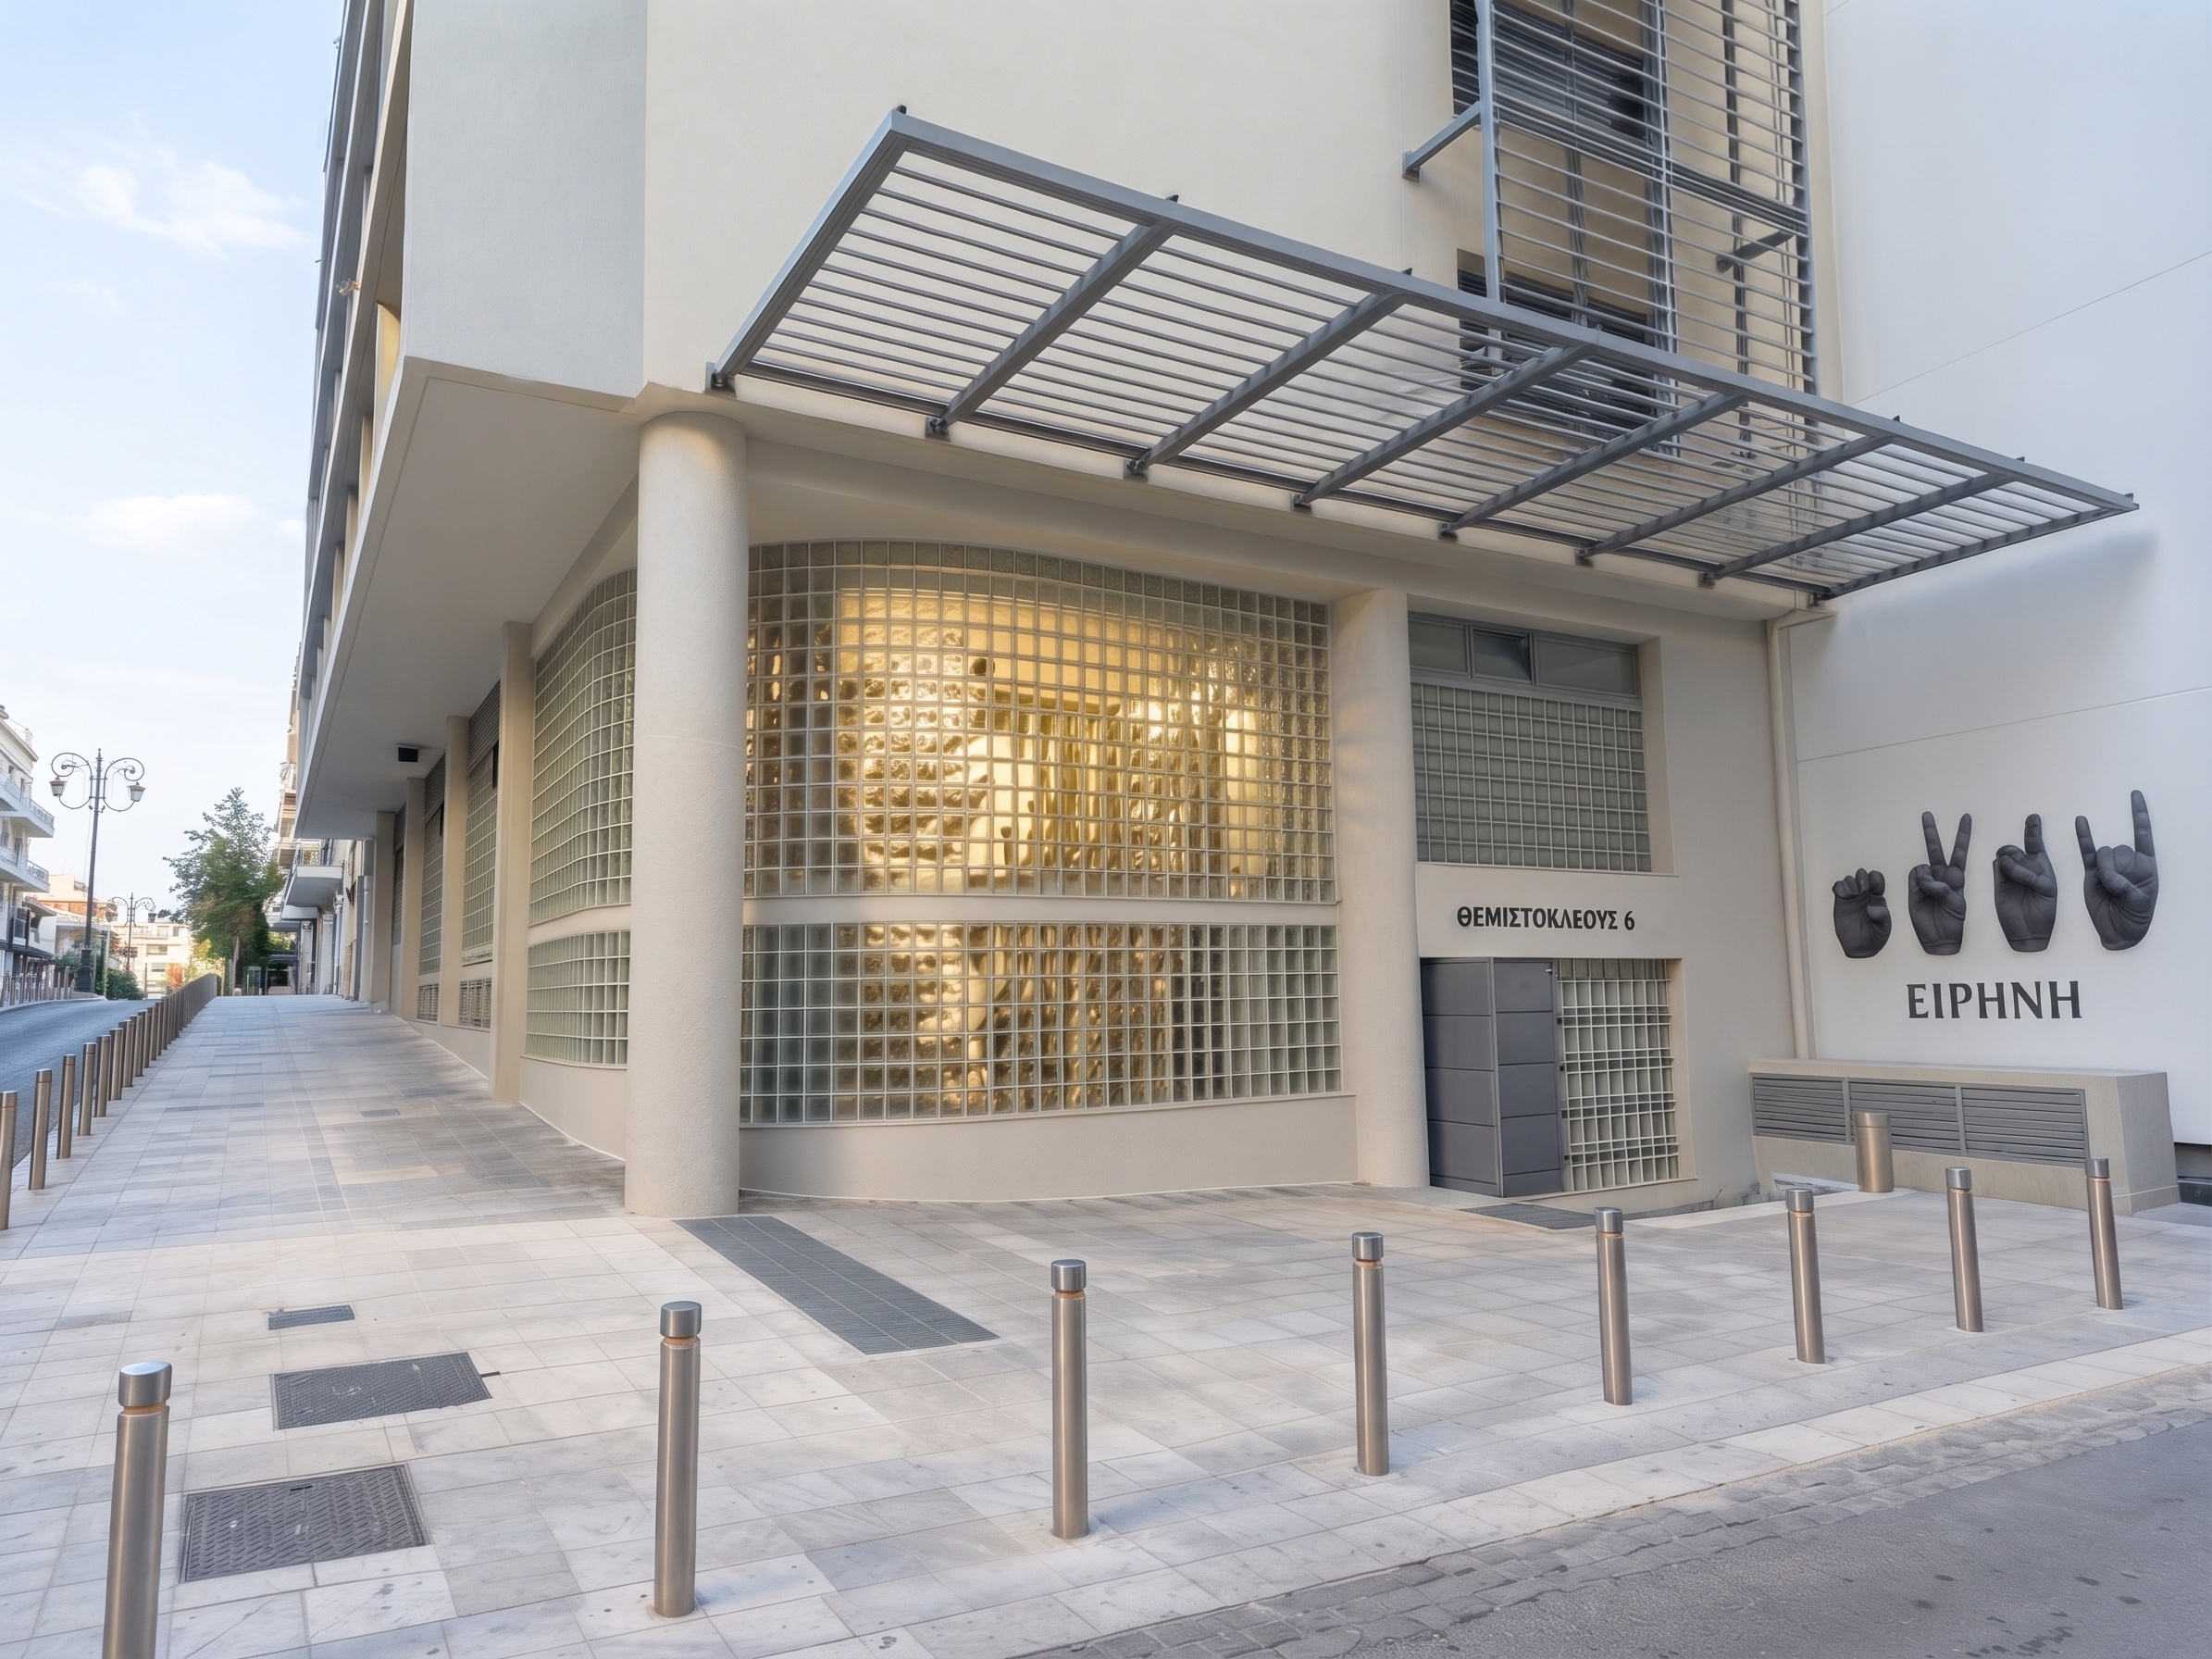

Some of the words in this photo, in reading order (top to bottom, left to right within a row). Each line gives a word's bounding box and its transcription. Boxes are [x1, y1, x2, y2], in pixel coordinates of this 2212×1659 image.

[1457, 905, 1619, 930] ΘΕΜΙΣΤΟΚΛΕΟΥΣ
[1623, 910, 1635, 931] 6
[1906, 980, 2083, 1019] ΕΙΡΗΝΗ
